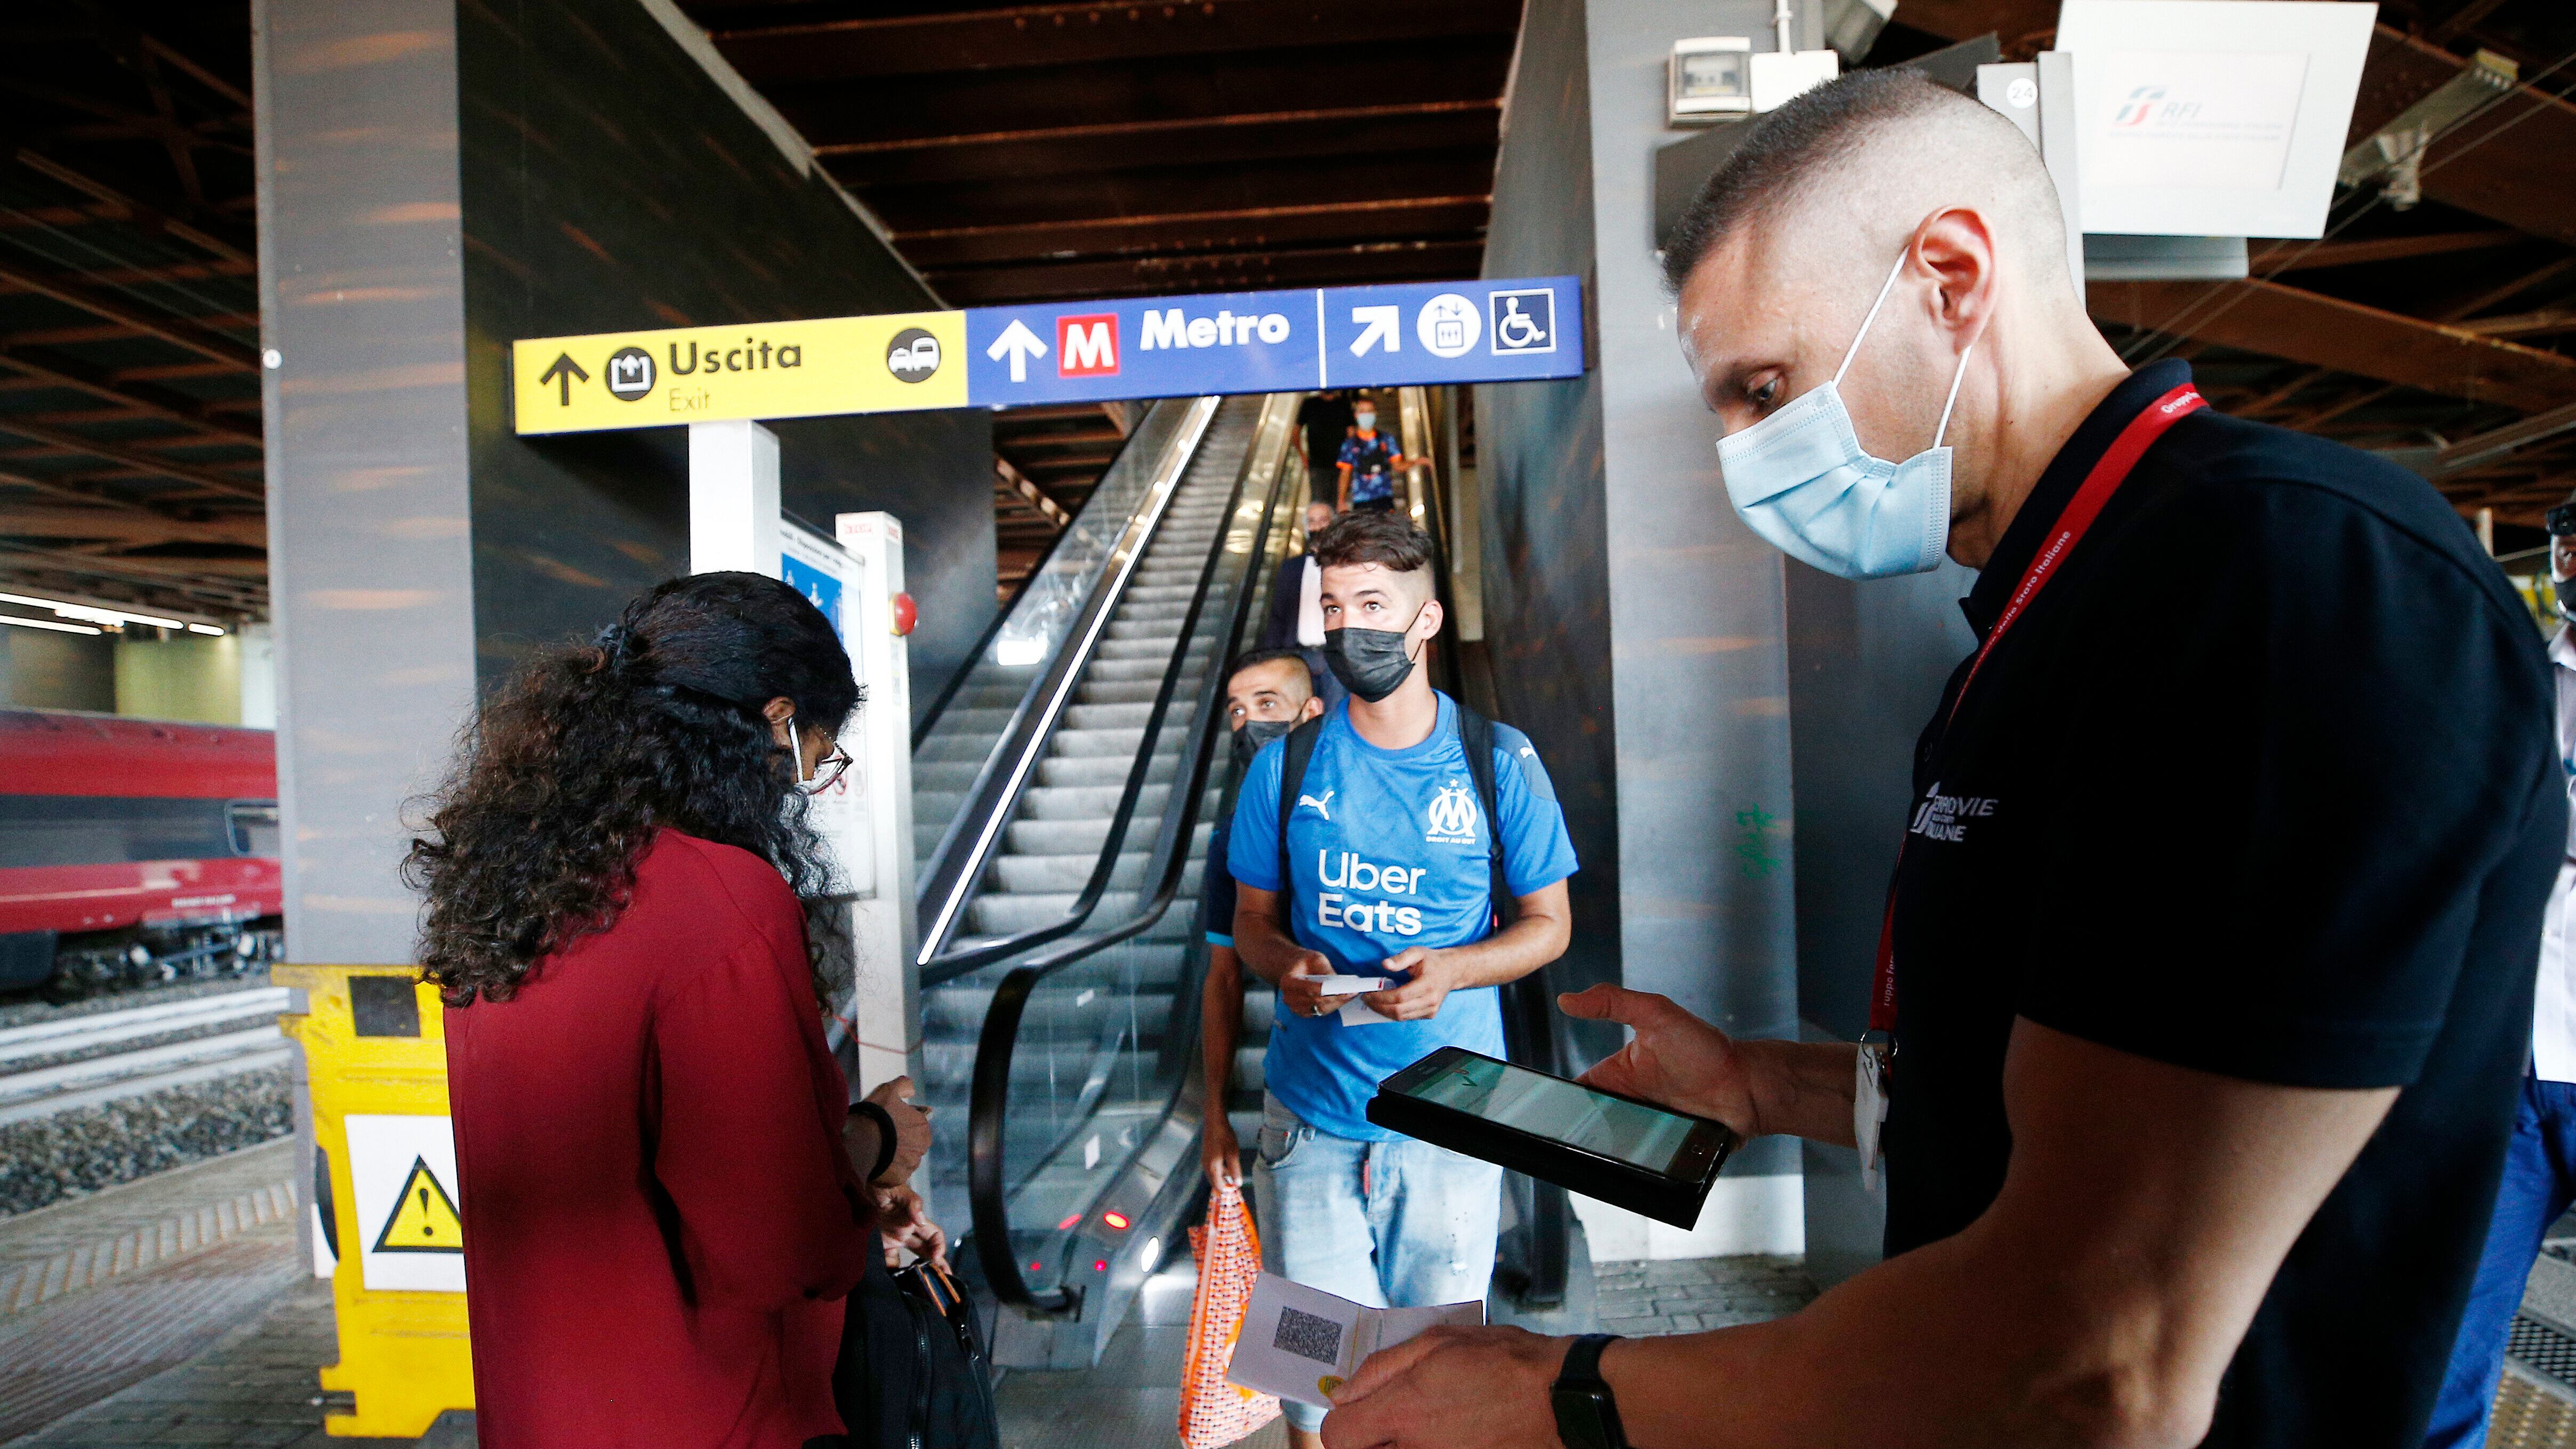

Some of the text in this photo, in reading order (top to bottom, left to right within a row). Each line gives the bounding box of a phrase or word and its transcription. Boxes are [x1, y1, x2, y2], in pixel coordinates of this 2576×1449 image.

[1063, 322, 1116, 370] M
[1139, 308, 1290, 351] Metro
[670, 338, 801, 375] Uscita
[669, 386, 710, 411] Exit
[2034, 531, 2071, 574] Italiane
[1319, 849, 1426, 895] Uber
[1318, 892, 1423, 935] Eats
